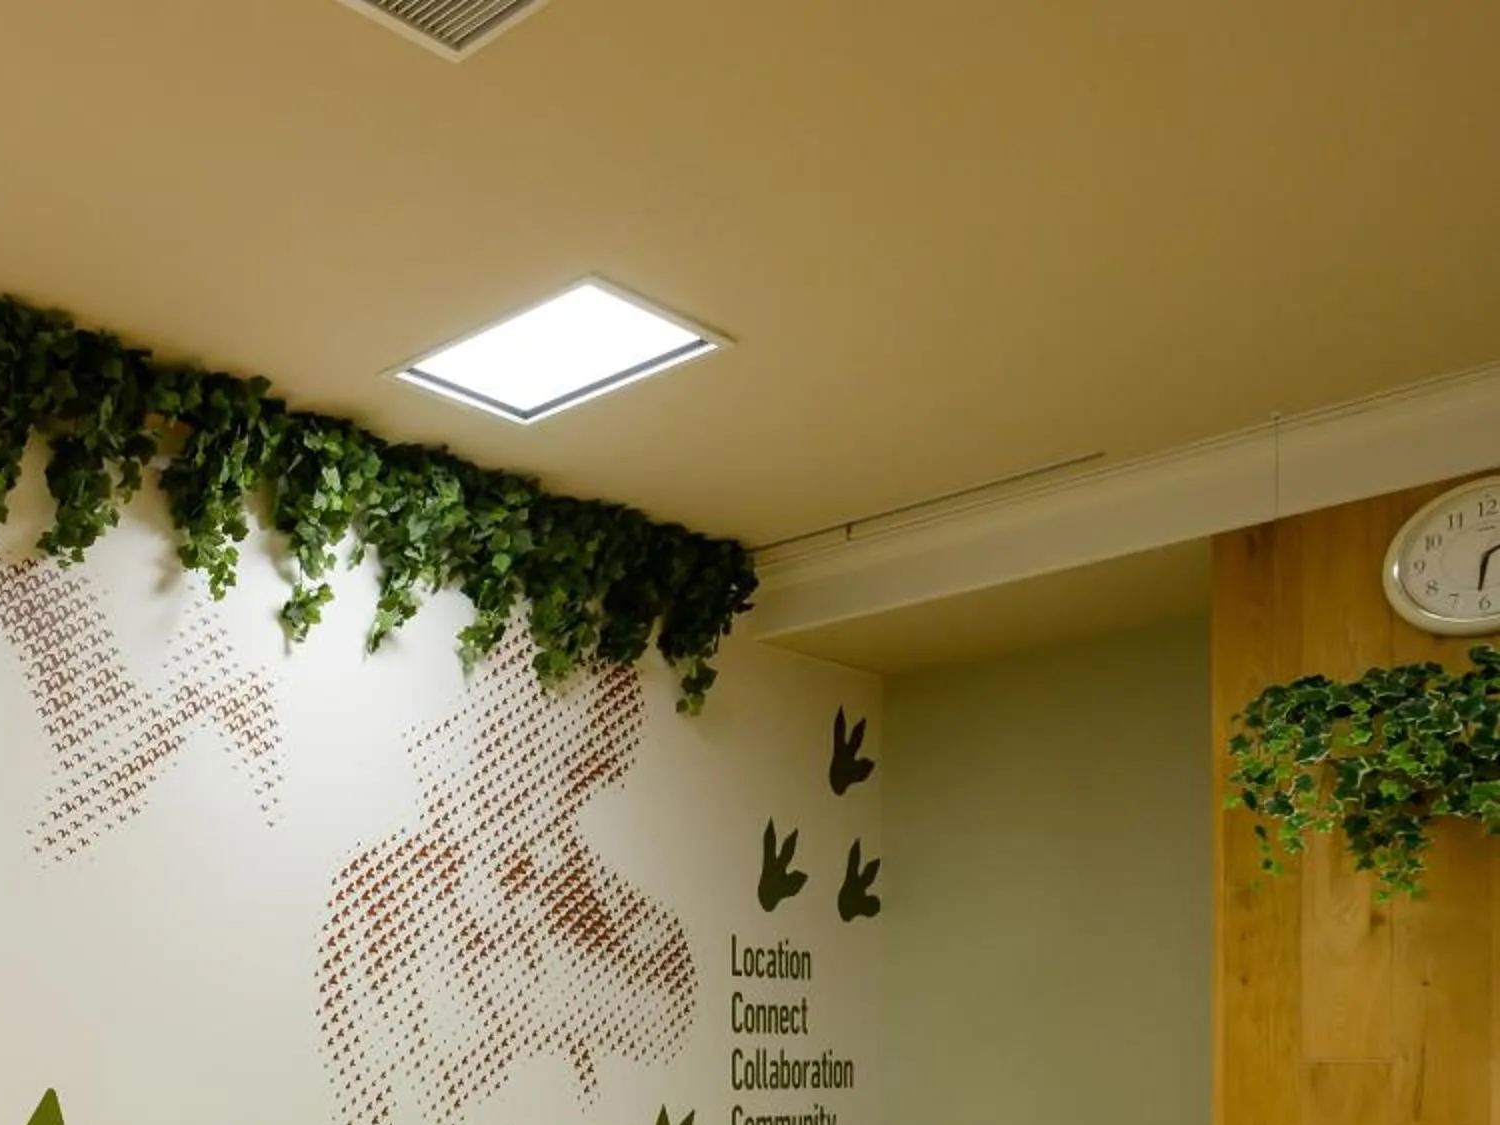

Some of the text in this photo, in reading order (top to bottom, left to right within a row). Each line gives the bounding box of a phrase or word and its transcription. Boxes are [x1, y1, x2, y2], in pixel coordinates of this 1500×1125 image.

[1478, 499, 1498, 518] 12
[1448, 512, 1463, 530] 11
[1425, 534, 1442, 552] 10
[1414, 560, 1426, 574] 9
[1426, 579, 1439, 596] 8
[1448, 592, 1460, 608] 7
[1478, 594, 1491, 610] 6
[731, 934, 811, 980] Location
[731, 992, 808, 1035] Connect
[731, 1048, 854, 1090] Collaboration
